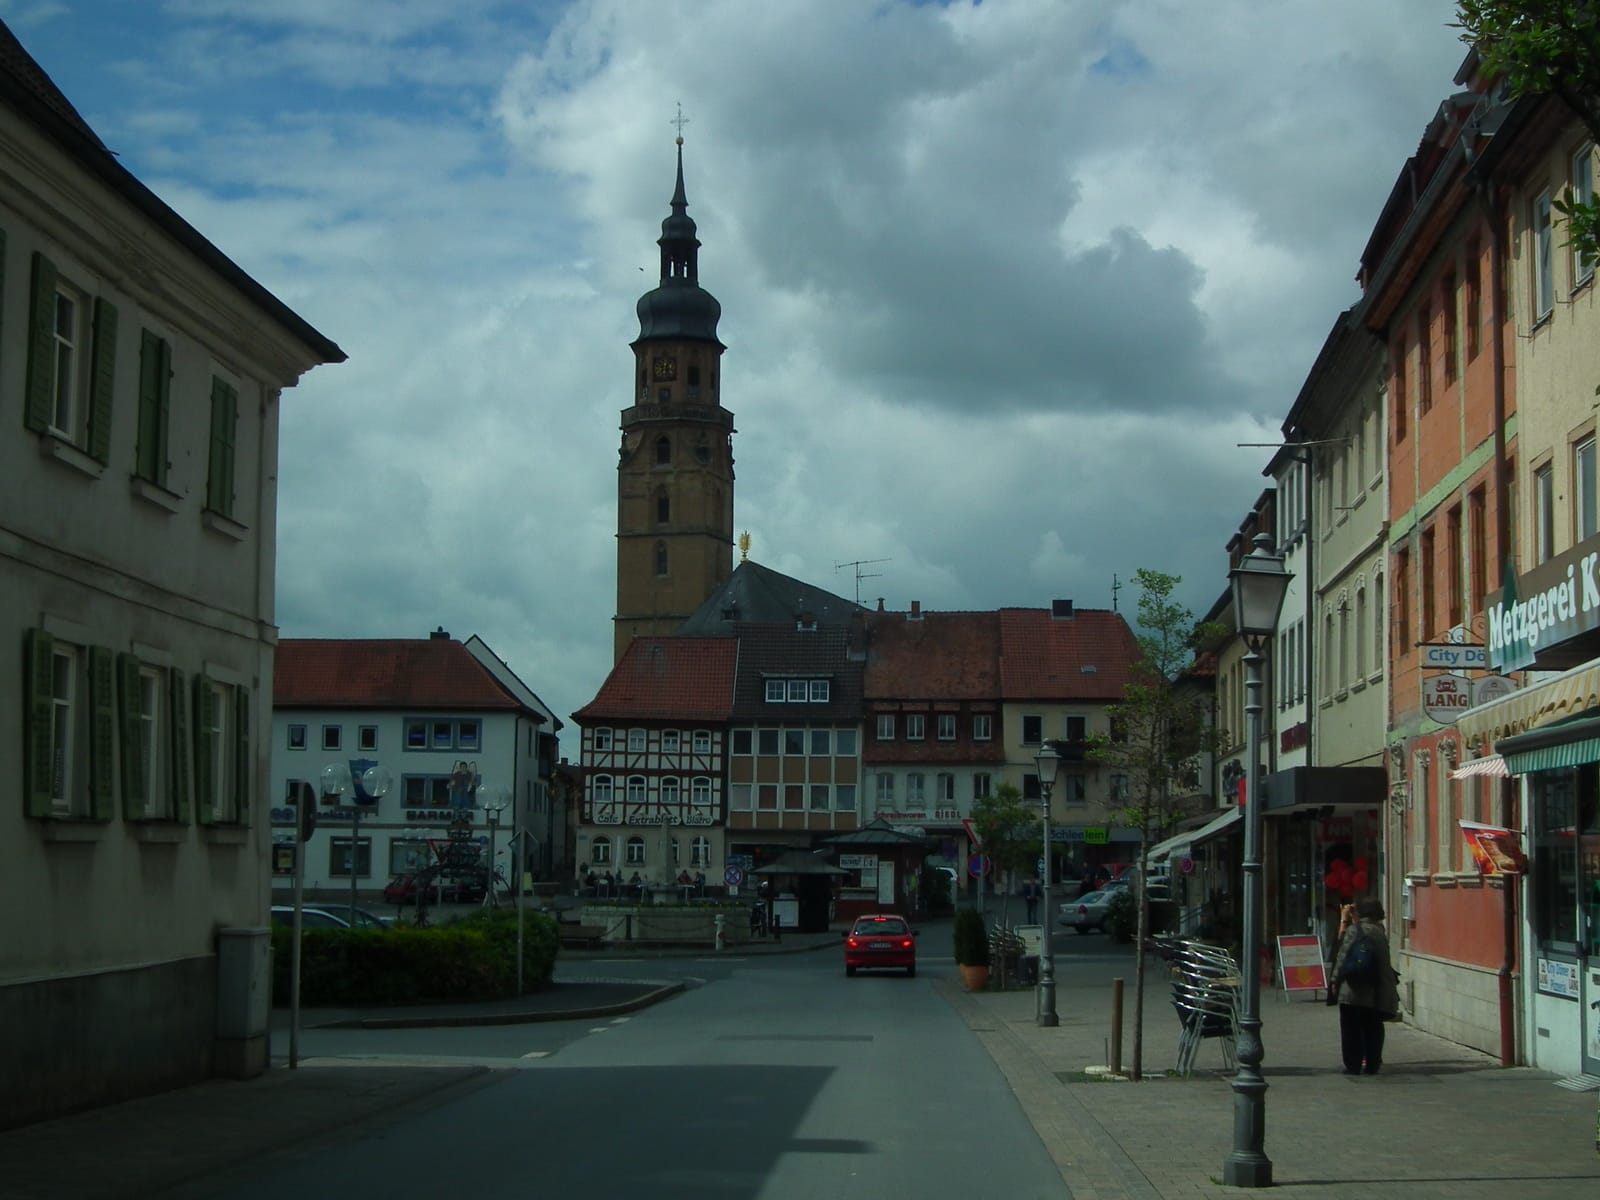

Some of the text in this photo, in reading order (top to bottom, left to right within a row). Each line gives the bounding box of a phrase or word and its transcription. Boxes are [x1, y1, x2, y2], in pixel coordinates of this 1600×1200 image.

[1488, 551, 1600, 652] Metzgerei K
[1428, 649, 1460, 664] City
[1425, 694, 1468, 707] LANG
